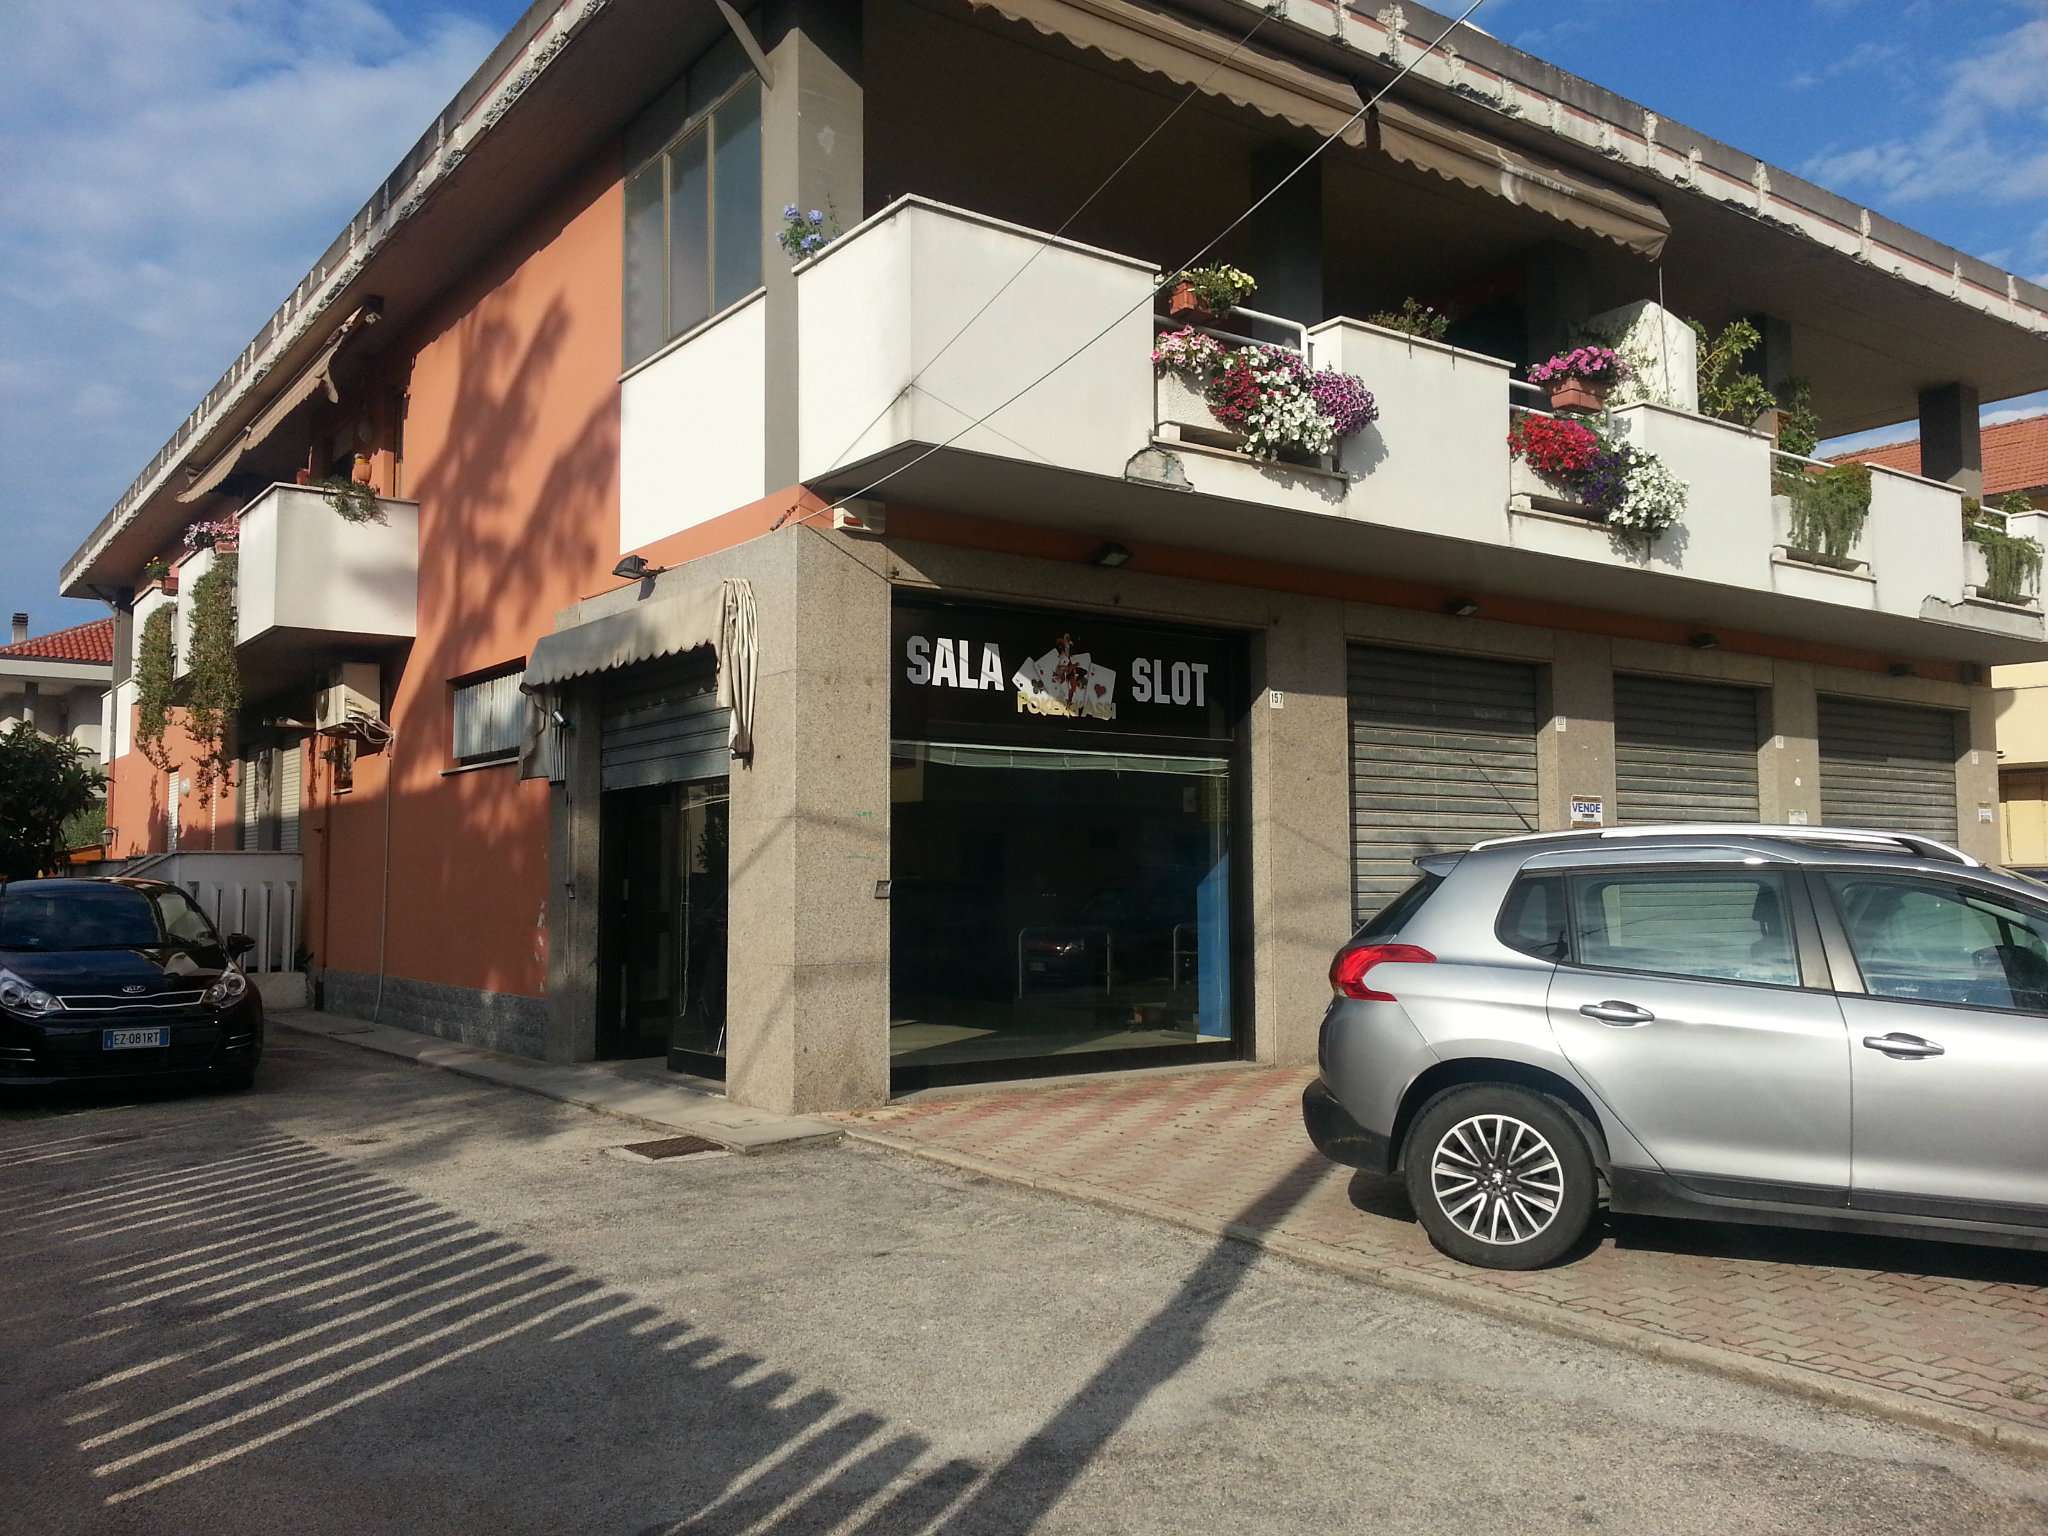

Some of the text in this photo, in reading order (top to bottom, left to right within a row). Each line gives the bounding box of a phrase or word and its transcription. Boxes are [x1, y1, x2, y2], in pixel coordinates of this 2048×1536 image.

[906, 636, 1208, 707] SALA SLOT
[1271, 692, 1283, 704] 157
[1572, 802, 1601, 813] VENDE
